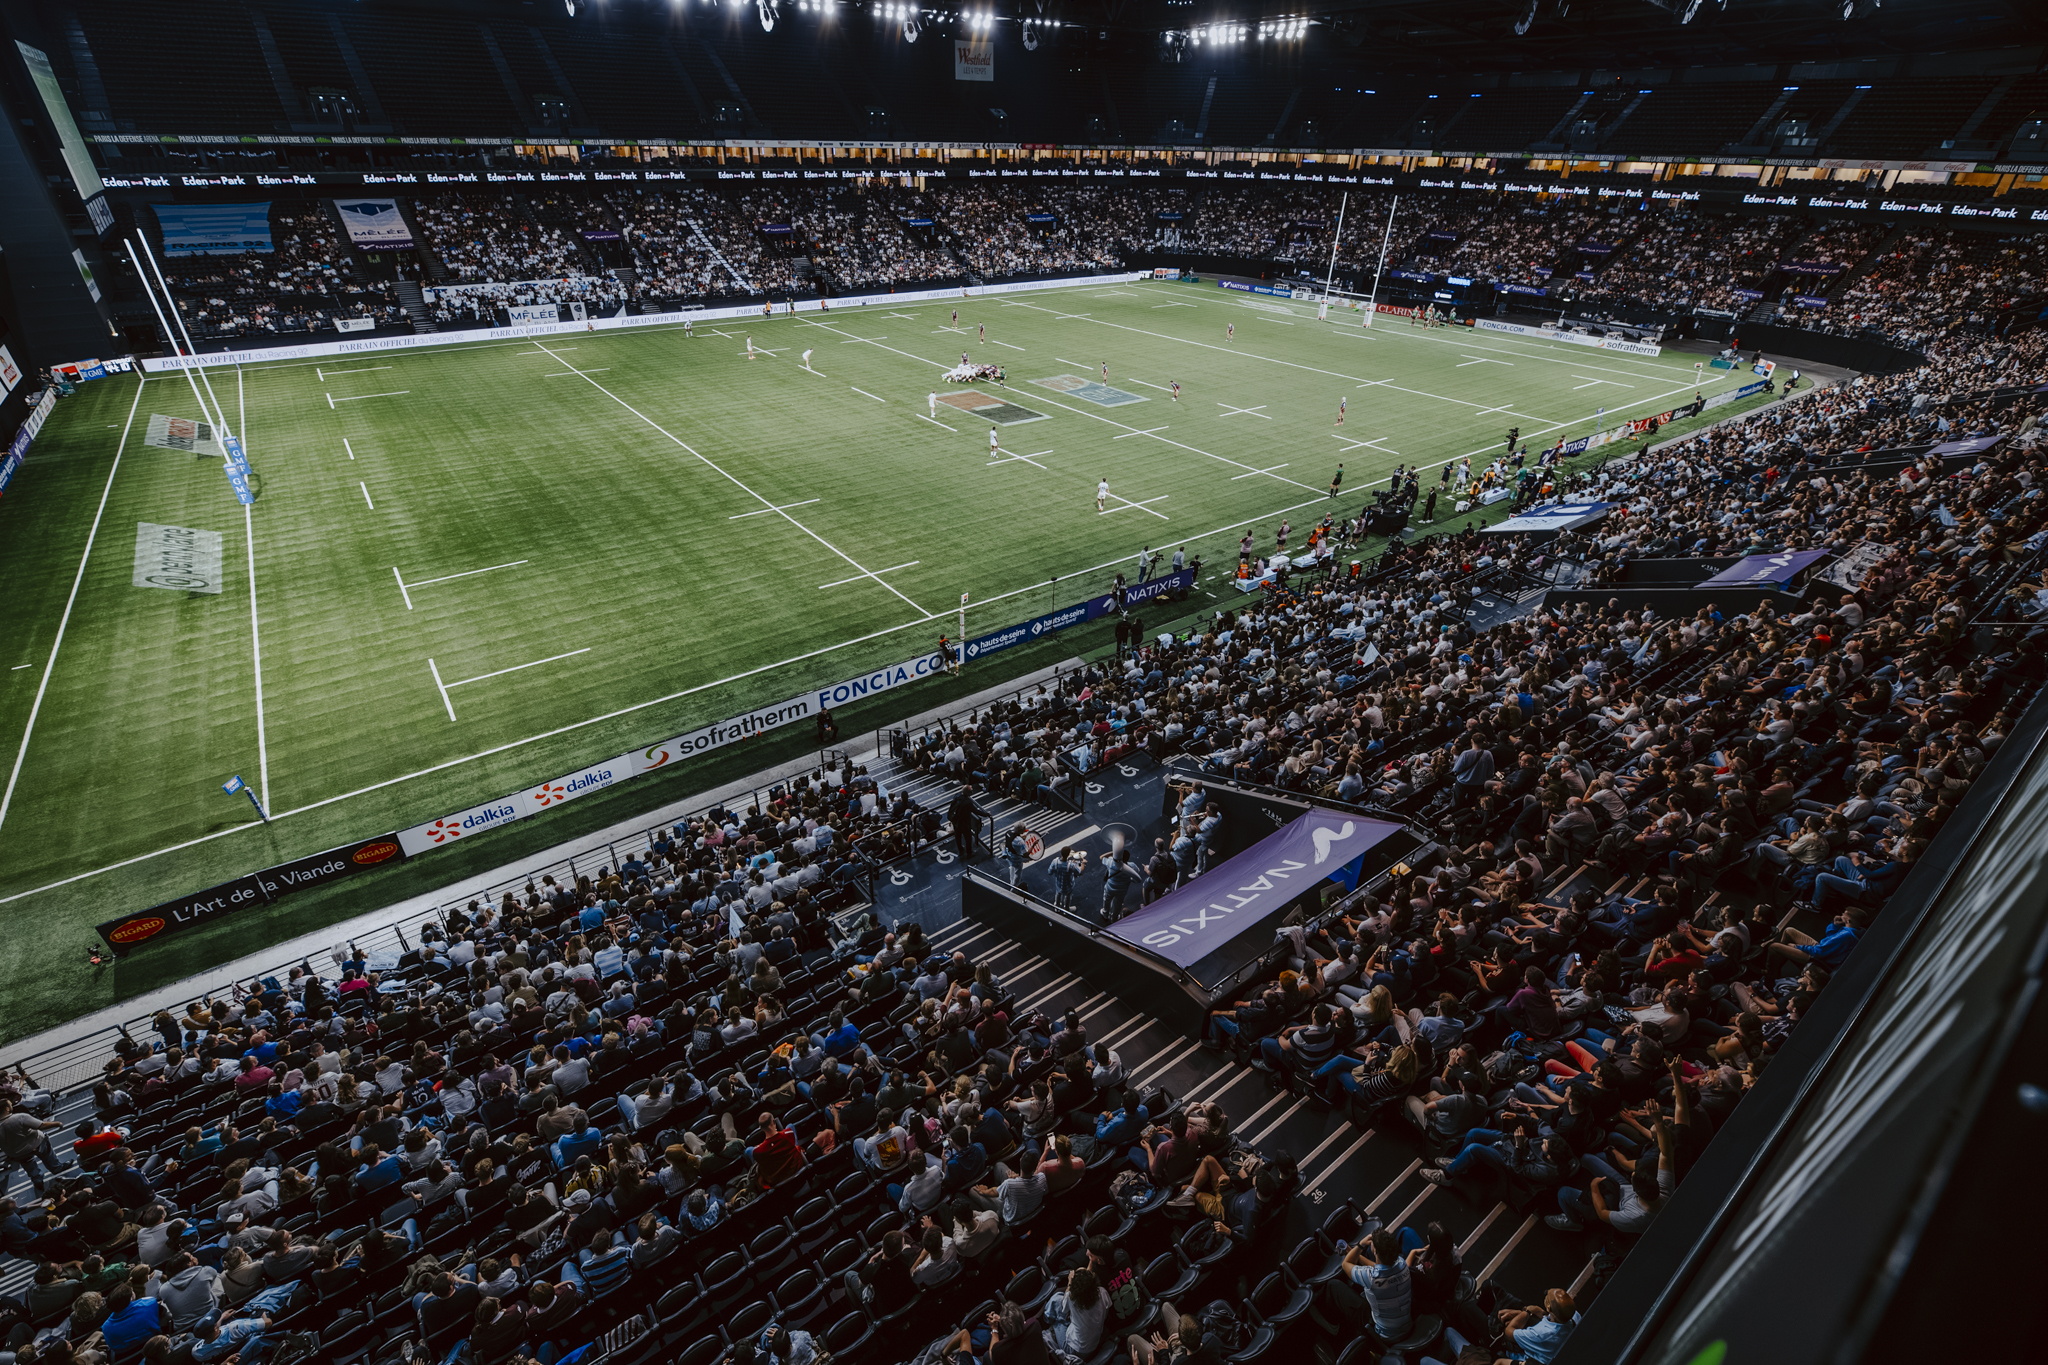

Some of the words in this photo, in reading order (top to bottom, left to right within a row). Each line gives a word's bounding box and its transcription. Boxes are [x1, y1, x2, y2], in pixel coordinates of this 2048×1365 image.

[182, 176, 208, 186] Eden
[219, 174, 245, 186] Park
[256, 174, 281, 184] Eden
[291, 174, 316, 184] Park
[363, 174, 386, 184] Eden
[394, 174, 417, 182] Park
[427, 174, 448, 182] Eden
[457, 172, 478, 182] Park
[487, 172, 507, 182] Eden
[515, 172, 535, 182] Park
[541, 172, 561, 180] Eden
[567, 172, 586, 180] Park
[595, 172, 612, 180] Eden
[619, 172, 637, 180] Park
[645, 172, 663, 180] Eden
[668, 172, 685, 180] Park
[762, 170, 777, 178] Eden
[782, 170, 797, 178] Park
[102, 176, 130, 188] Eden
[143, 176, 170, 186] Park
[1420, 178, 1435, 186] Eden
[1441, 180, 1454, 188] Park
[1504, 184, 1521, 192] Eden
[1528, 184, 1543, 192] Park
[1548, 184, 1566, 194] Eden
[1573, 186, 1590, 194] Park
[1598, 188, 1619, 196] Eden
[1625, 188, 1643, 198] Park
[1652, 190, 1673, 198] Eden
[1681, 192, 1700, 200] Park
[1743, 194, 1767, 204] Eden
[1776, 196, 1798, 206] Park
[1809, 198, 1835, 206] Eden
[1845, 200, 1868, 210] Park
[1880, 200, 1908, 210] Eden
[1919, 204, 1943, 214] Park
[1952, 204, 1980, 216] Eden
[1991, 208, 2018, 218] Park
[2031, 210, 2048, 220] Ede
[172, 241, 237, 249] RACING
[1230, 282, 1249, 291] NATIXIS
[511, 309, 556, 320] MÊLÉE
[1482, 321, 1524, 333] FONCIA.COM
[339, 342, 378, 352] PARRAIN
[380, 338, 417, 348] OFFICIEL
[430, 335, 454, 344] Racing
[1607, 341, 1656, 354] sofratherm
[210, 353, 254, 363] OFFICIEL
[269, 350, 296, 359] Racing
[88, 368, 103, 377] GMF
[233, 450, 245, 472] GMF
[233, 478, 246, 501] GMF
[1126, 577, 1181, 603] NATIXIS
[680, 702, 807, 754] sofratherm
[566, 768, 612, 792] dalkia
[580, 786, 600, 795] GROUPE
[462, 804, 514, 829] dalkia
[479, 820, 501, 831] GROUPE
[356, 844, 394, 861] BIGARD
[172, 898, 226, 922] L'Art
[230, 884, 255, 903] de
[258, 878, 278, 894] la
[280, 858, 346, 885] Viande
[1142, 859, 1307, 948] NATIXIS
[113, 918, 161, 941] BIGARD
[413, 1092, 428, 1105] 10
[1311, 1189, 1322, 1200] 26
[1108, 1267, 1132, 1291] arte
